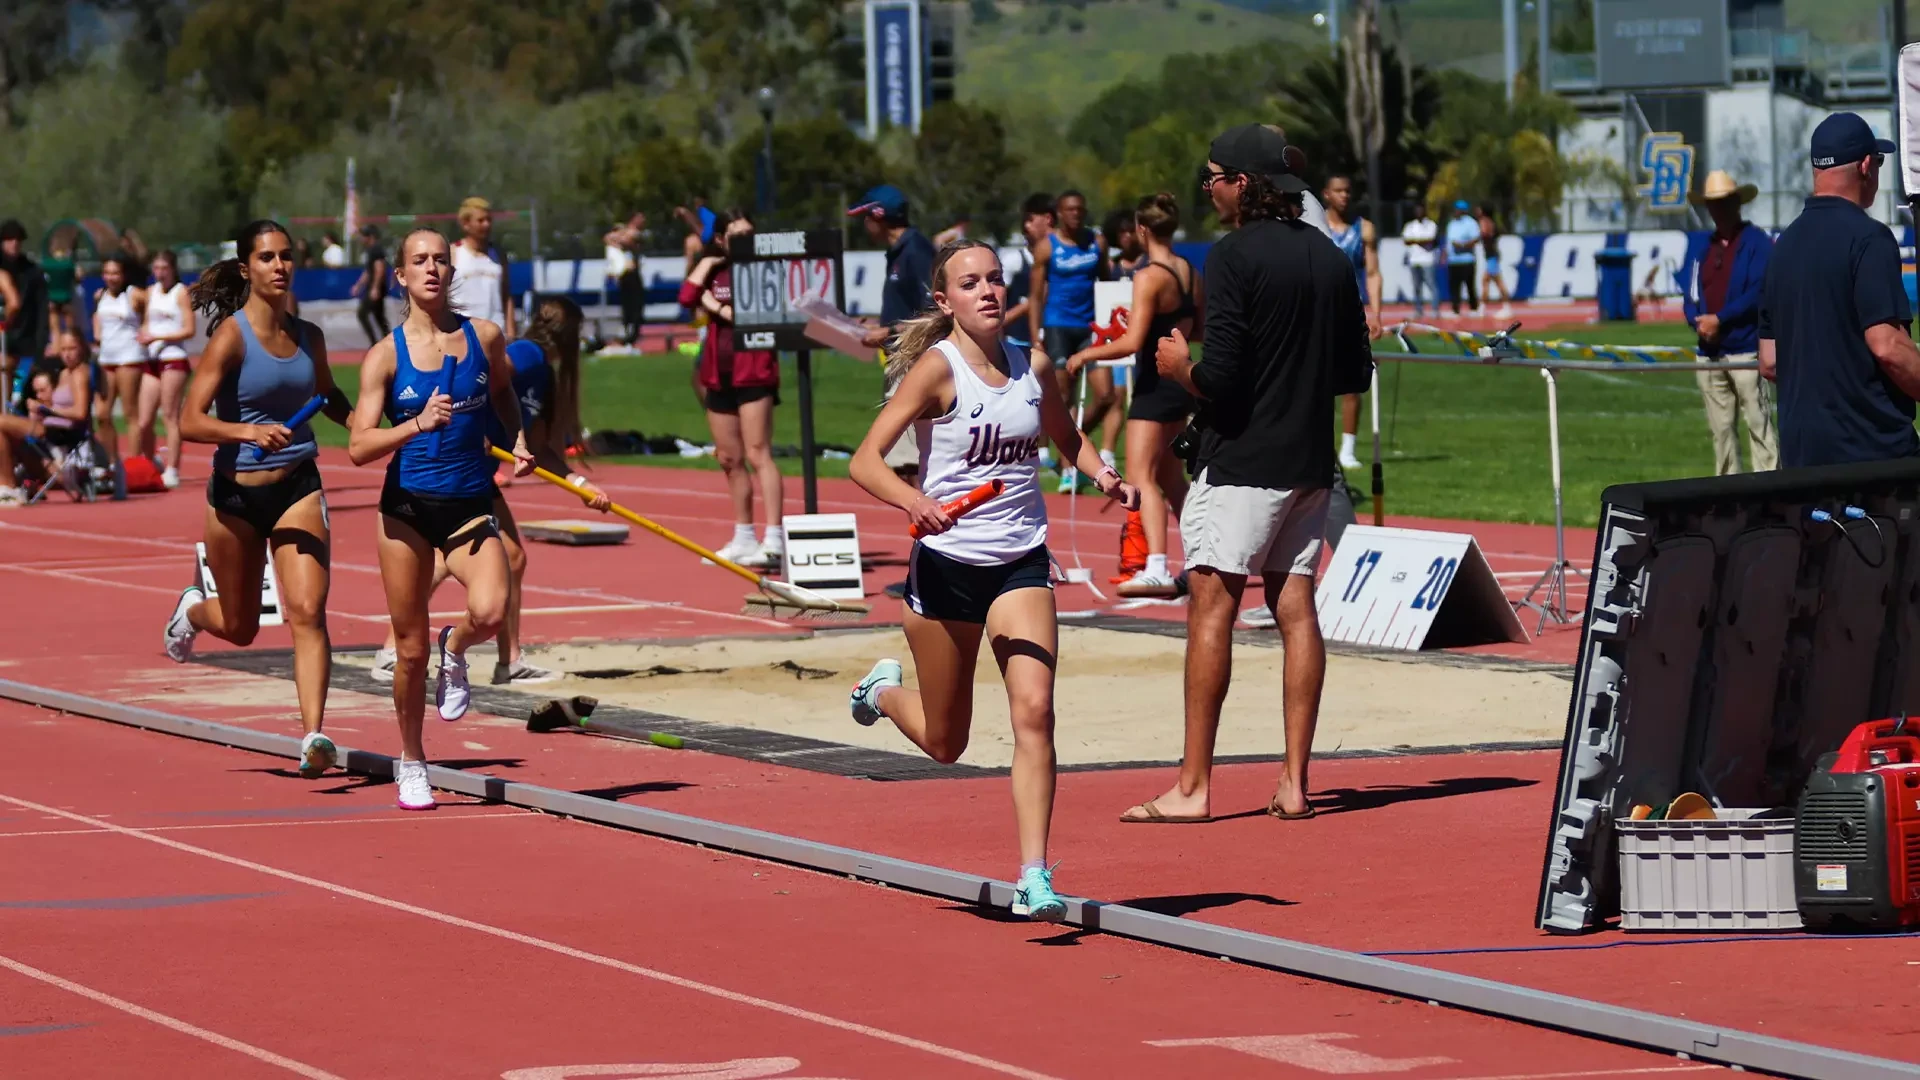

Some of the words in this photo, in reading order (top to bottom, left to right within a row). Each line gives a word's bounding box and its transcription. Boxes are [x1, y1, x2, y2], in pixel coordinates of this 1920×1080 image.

[744, 332, 776, 348] UCS
[790, 553, 855, 566] UCS
[1342, 549, 1383, 603] 17
[1410, 556, 1457, 611] 20
